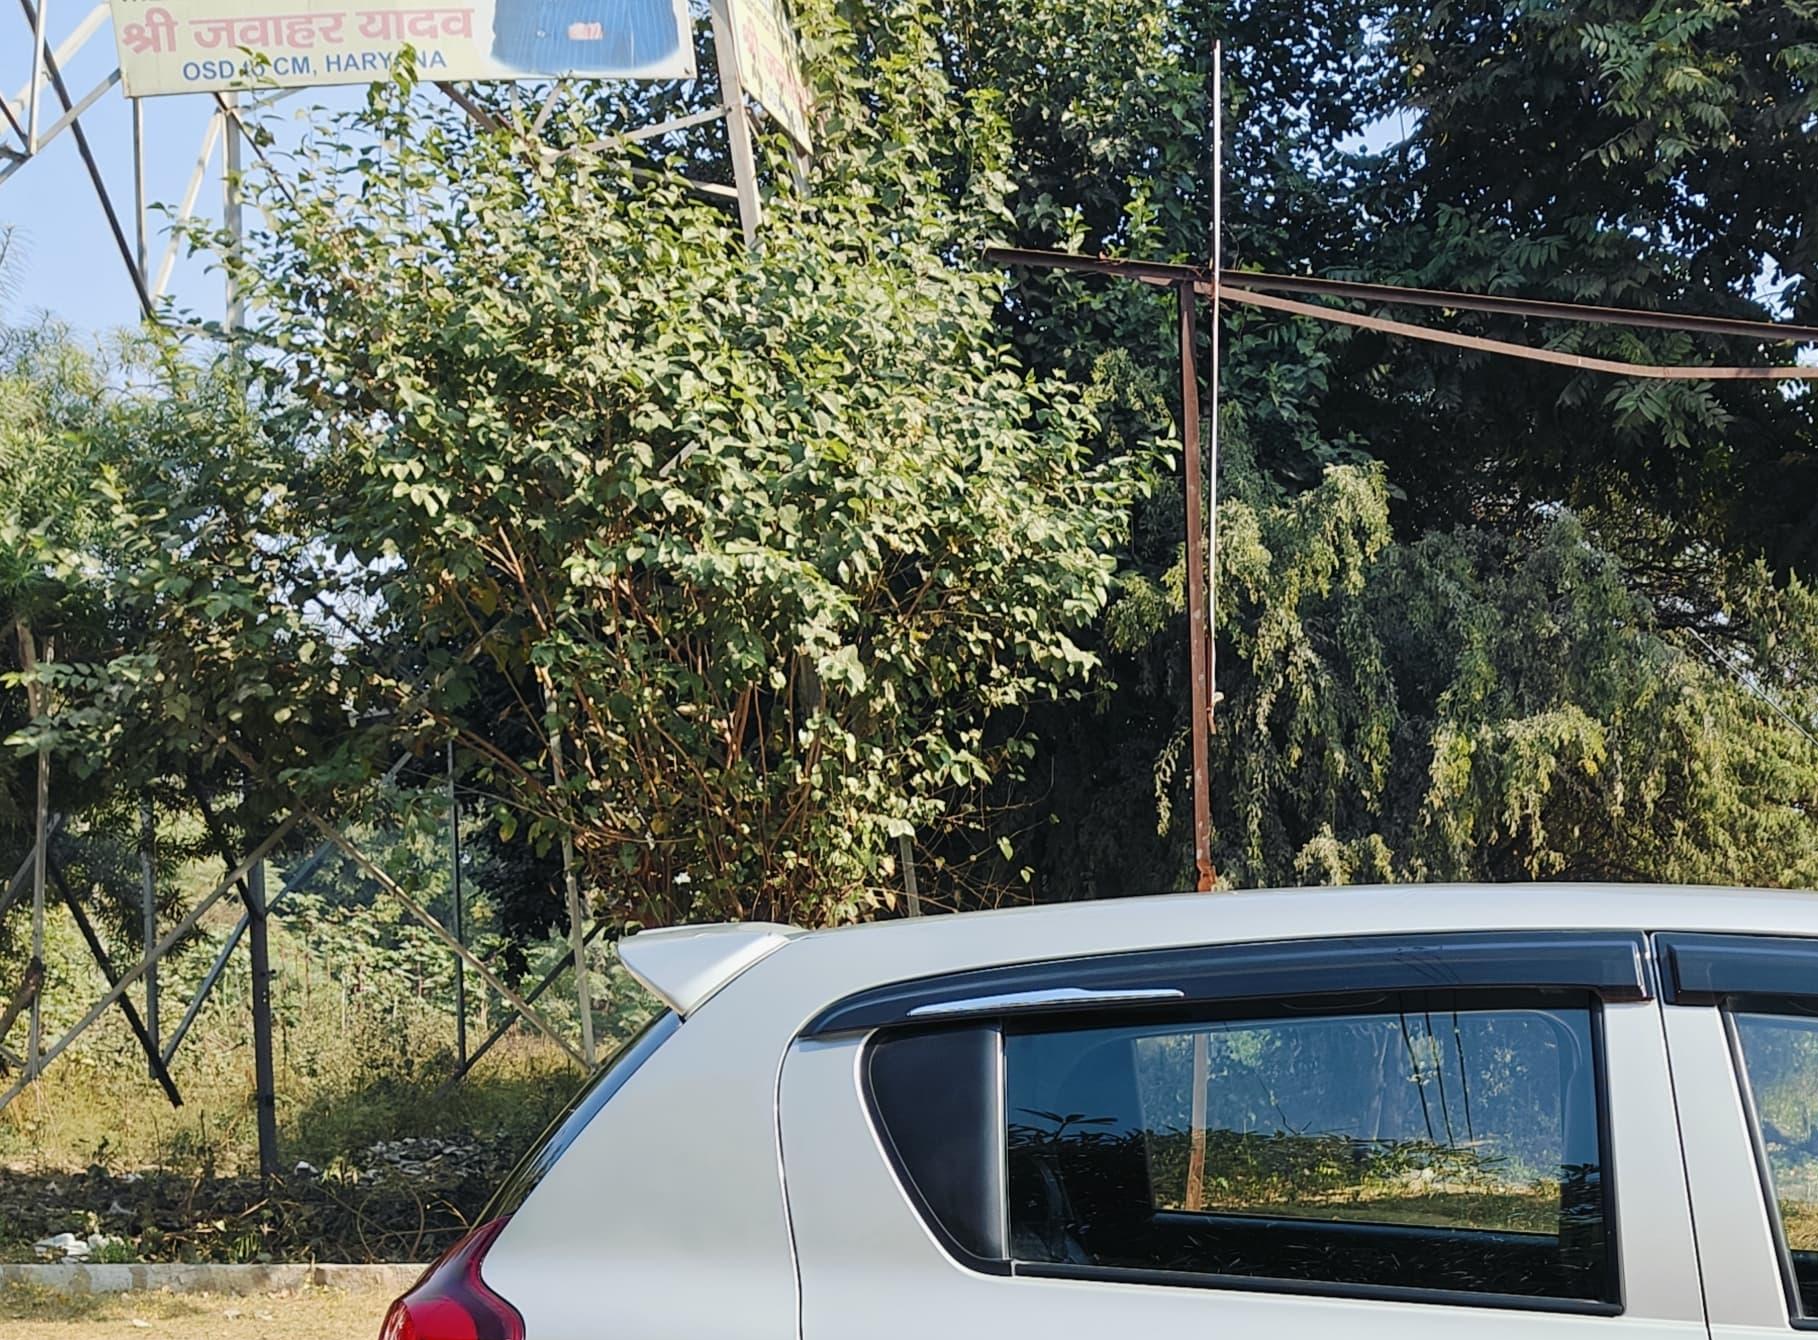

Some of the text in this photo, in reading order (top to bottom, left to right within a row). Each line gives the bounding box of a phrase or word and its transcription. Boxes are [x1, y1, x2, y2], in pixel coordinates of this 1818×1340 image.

[122, 7, 475, 53] श्री जवाहर यादव
[183, 58, 235, 81] OSD
[273, 54, 317, 78] CM,
[325, 51, 447, 73] HARYNA
